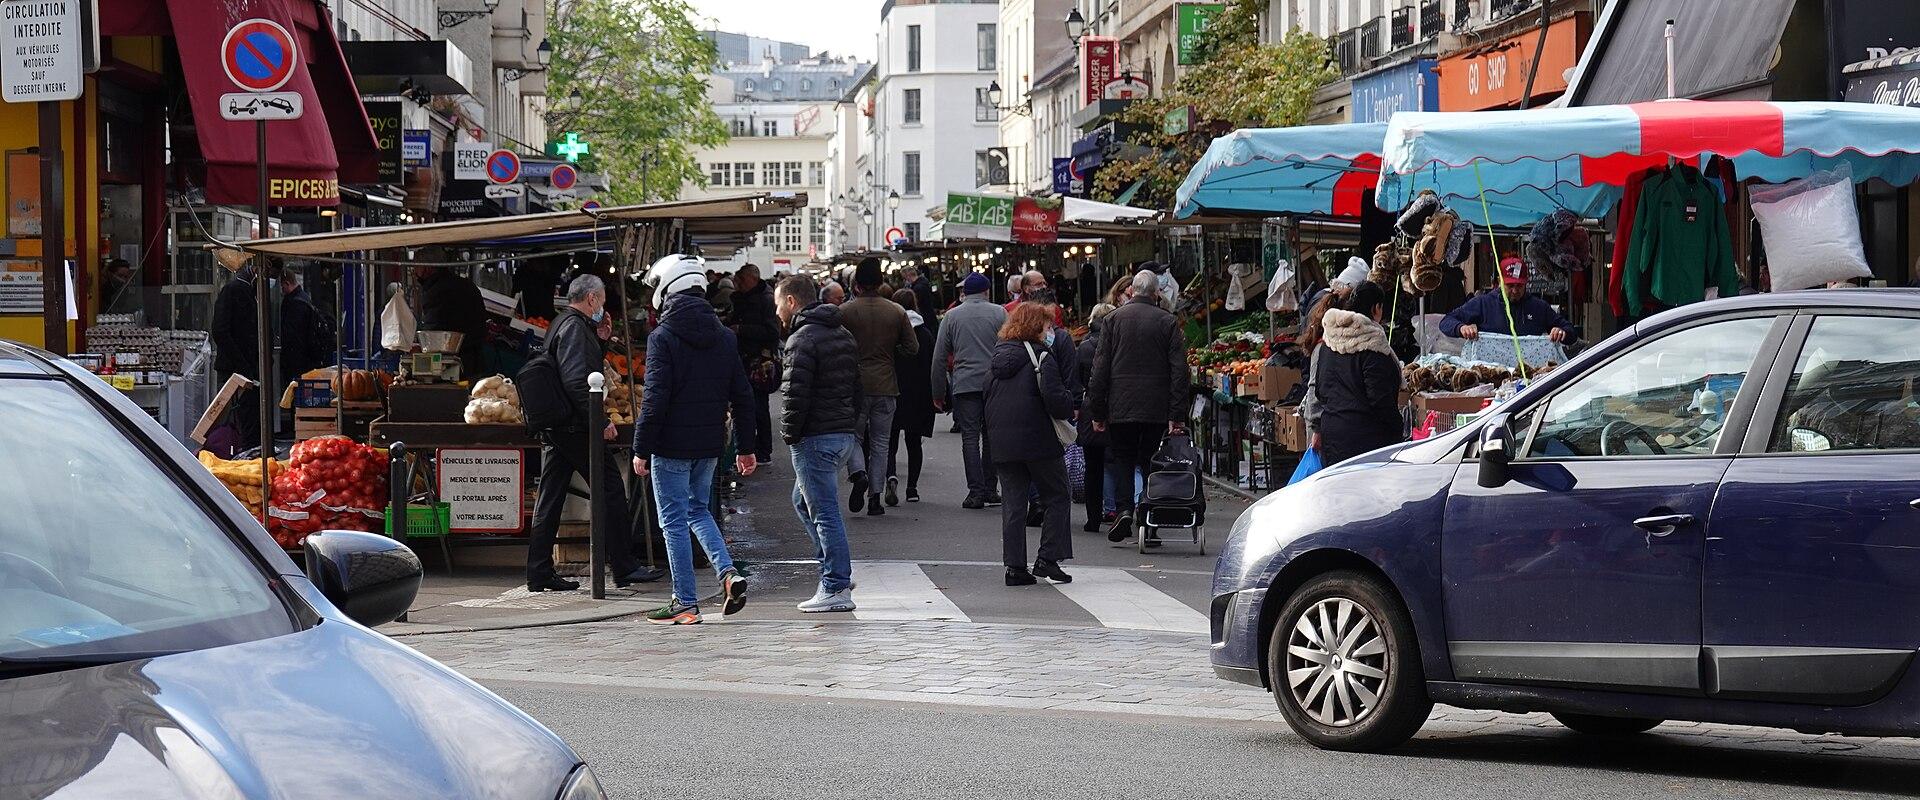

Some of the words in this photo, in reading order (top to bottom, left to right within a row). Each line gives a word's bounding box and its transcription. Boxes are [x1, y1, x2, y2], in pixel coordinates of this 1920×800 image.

[5, 2, 66, 19] CIRCULATION
[14, 22, 62, 38] INTERDITE
[16, 46, 26, 56] AUX
[29, 44, 60, 55] VÉHICULES
[23, 55, 55, 68] MOTORISÉS
[31, 70, 46, 80] SAUF
[1468, 62, 1480, 96] GO
[1487, 55, 1507, 90] SHOP
[13, 83, 41, 95] DESSERTE
[43, 82, 67, 93] INTERNE
[458, 150, 488, 159] FRED
[270, 178, 324, 200] EPICES
[948, 203, 974, 223] AB
[981, 205, 1007, 226] AB
[1034, 212, 1048, 221] BIO
[1033, 224, 1056, 233] LOCAL
[442, 457, 473, 465] VÉHICULES
[479, 476, 511, 484] REFERMER
[488, 494, 508, 502] APRÈS
